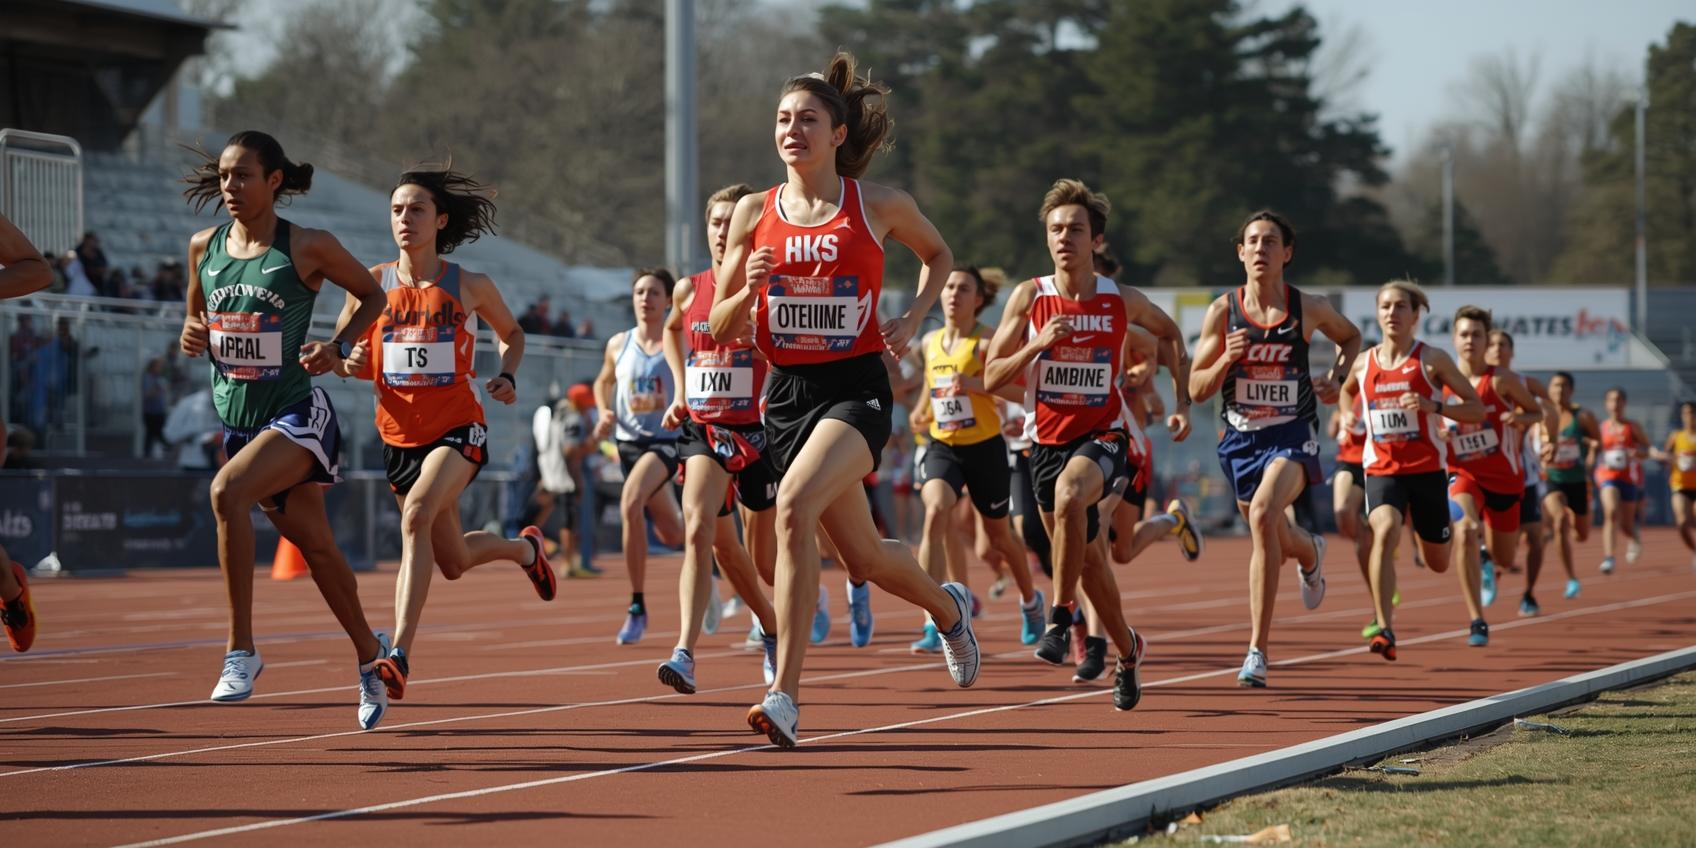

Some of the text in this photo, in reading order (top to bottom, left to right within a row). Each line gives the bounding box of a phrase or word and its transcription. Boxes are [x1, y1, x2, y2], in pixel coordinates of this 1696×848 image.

[785, 234, 839, 263] HKS
[404, 347, 428, 368] TS
[1044, 366, 1105, 388] AMBINE
